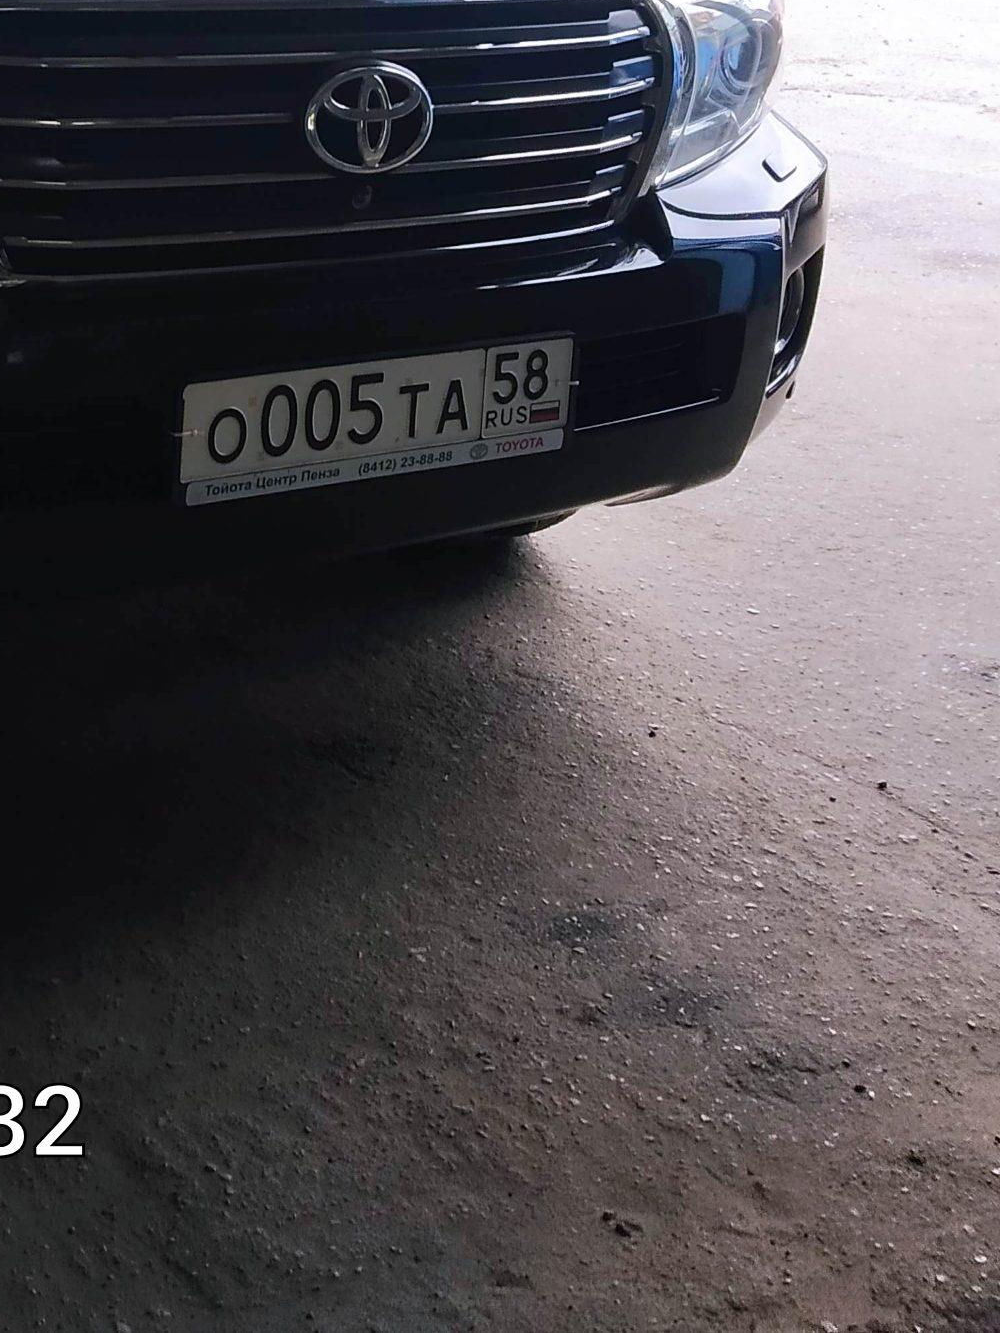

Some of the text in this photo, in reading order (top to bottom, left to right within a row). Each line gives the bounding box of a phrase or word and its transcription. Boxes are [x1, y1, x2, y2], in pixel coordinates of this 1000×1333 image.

[492, 349, 549, 405] 58
[485, 405, 527, 429] RUS
[495, 436, 545, 454] TOYOTA
[204, 450, 453, 498] Тойота Центр Пенза (8412) 23-88-88
